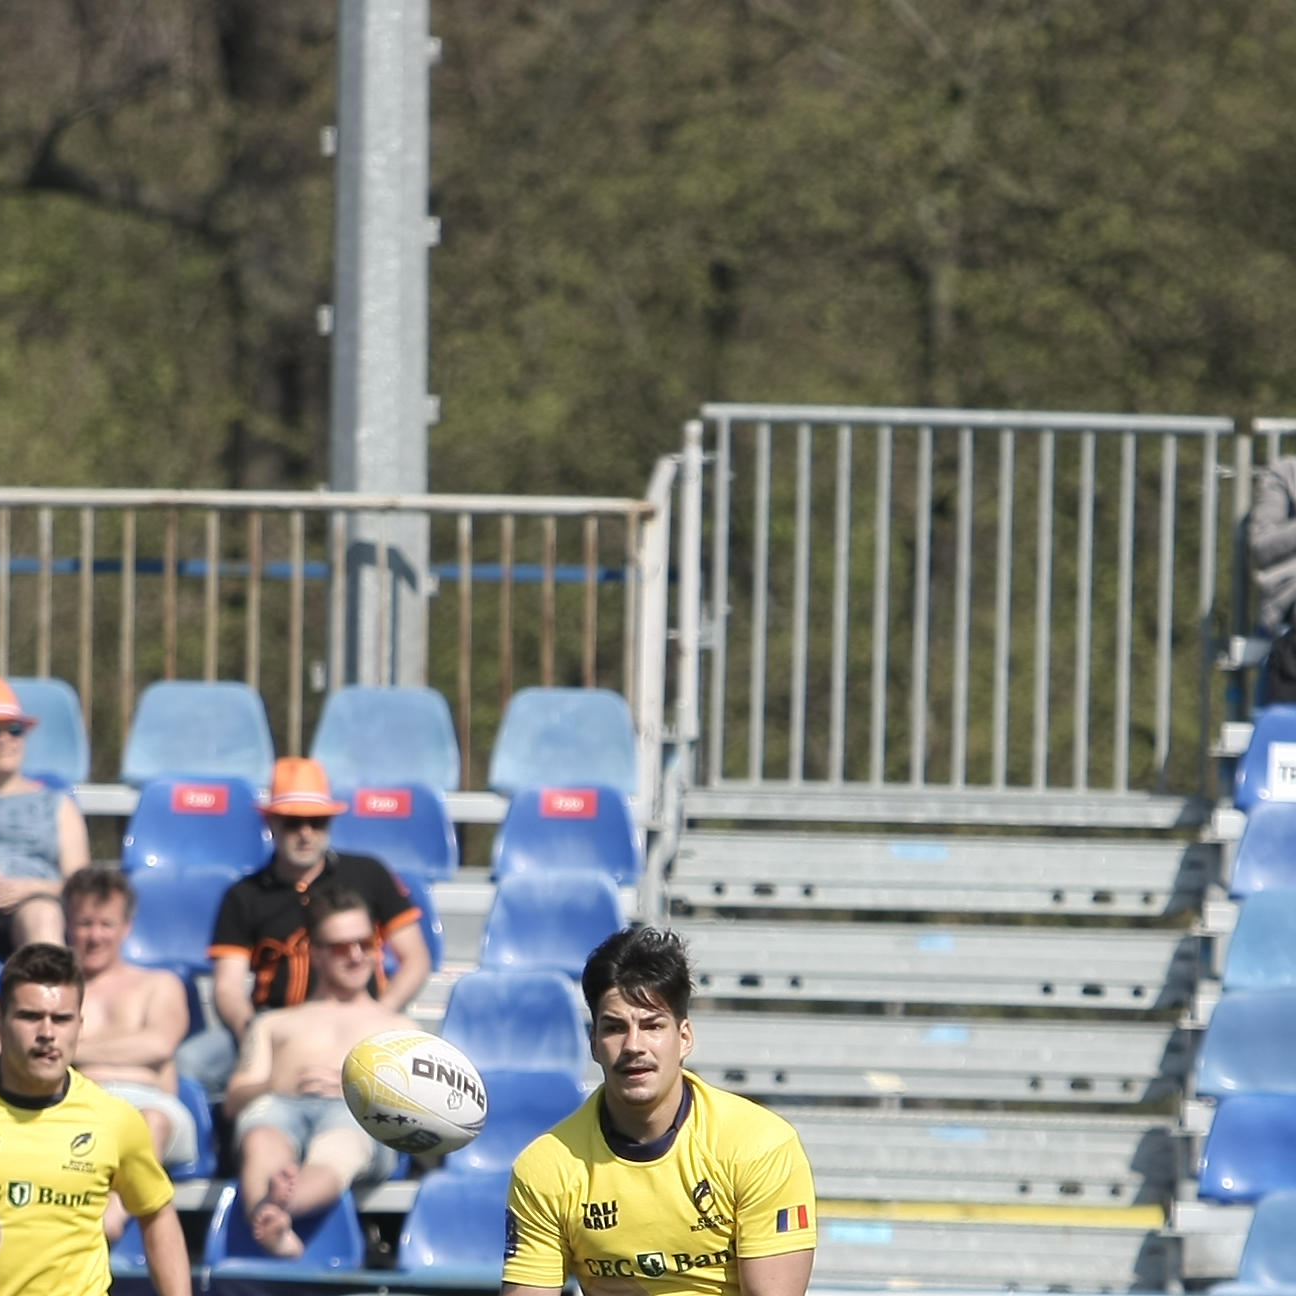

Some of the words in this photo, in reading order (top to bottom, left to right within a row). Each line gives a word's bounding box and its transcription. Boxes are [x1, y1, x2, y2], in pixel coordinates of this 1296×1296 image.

[412, 1056, 486, 1113] RHINO
[581, 1200, 618, 1218] TALL
[583, 1214, 618, 1231] BALL
[584, 1258, 635, 1277] CEC
[672, 1248, 734, 1274] Ban
